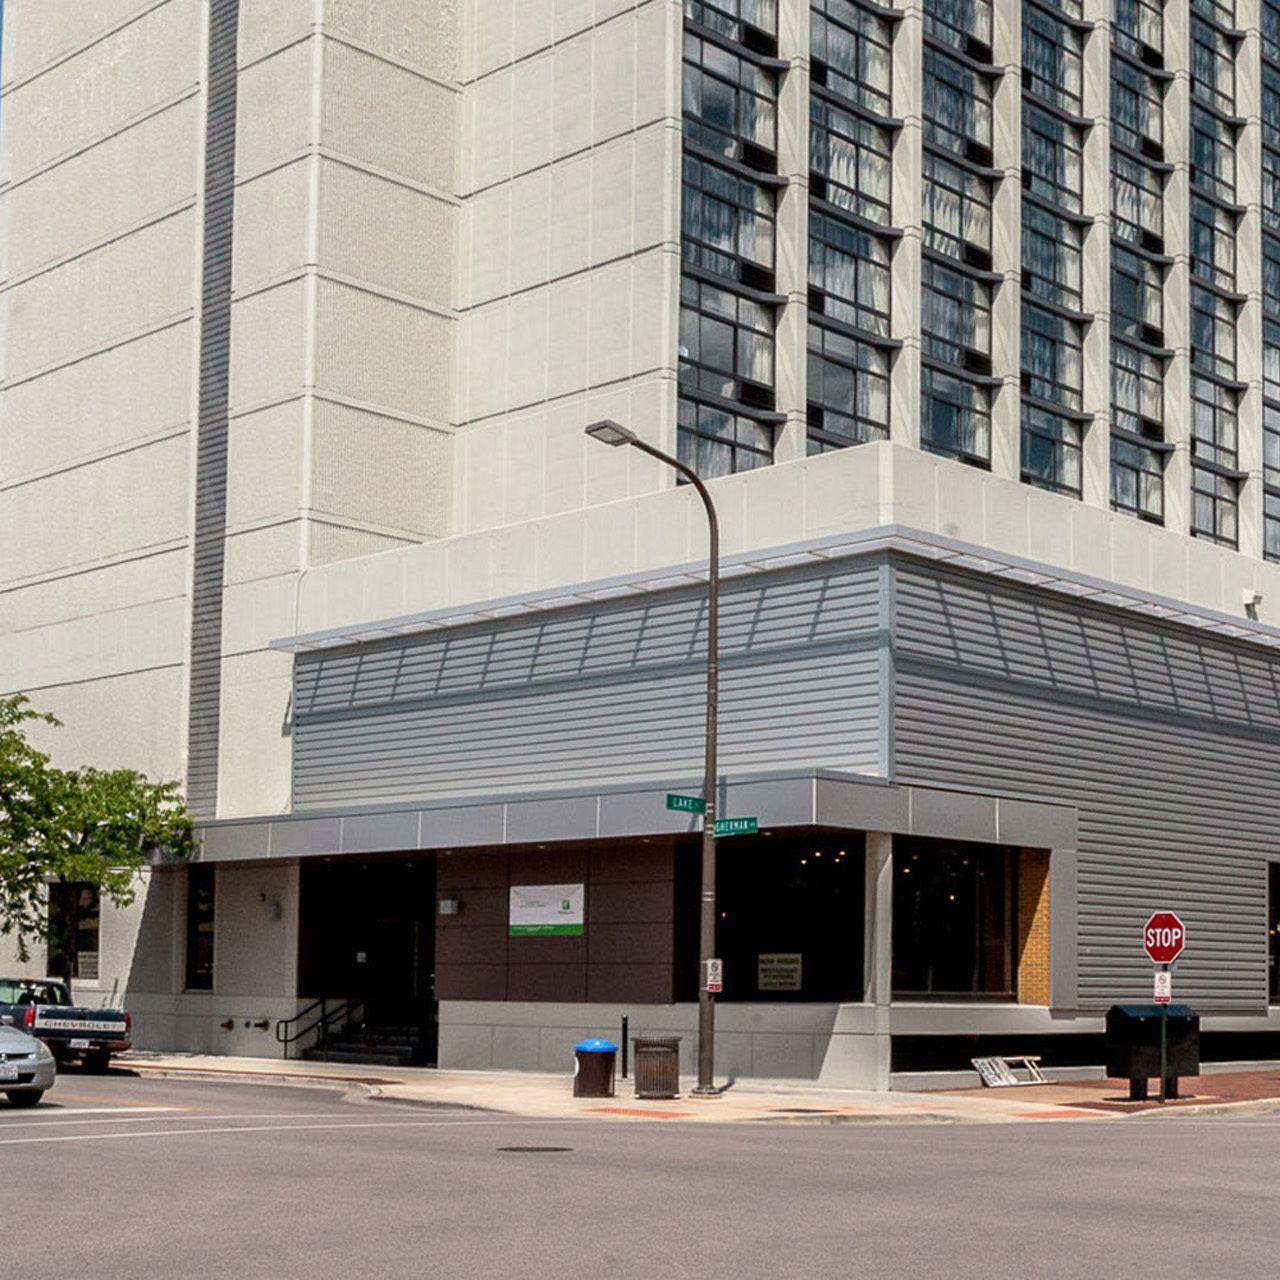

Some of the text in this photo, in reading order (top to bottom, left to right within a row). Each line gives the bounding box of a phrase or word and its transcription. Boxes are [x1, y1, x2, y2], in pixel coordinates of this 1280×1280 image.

[673, 797, 693, 810] LAKE
[716, 820, 748, 832] SHERMAN
[1146, 928, 1181, 948] STOP
[44, 1020, 117, 1030] CHEVROLET
